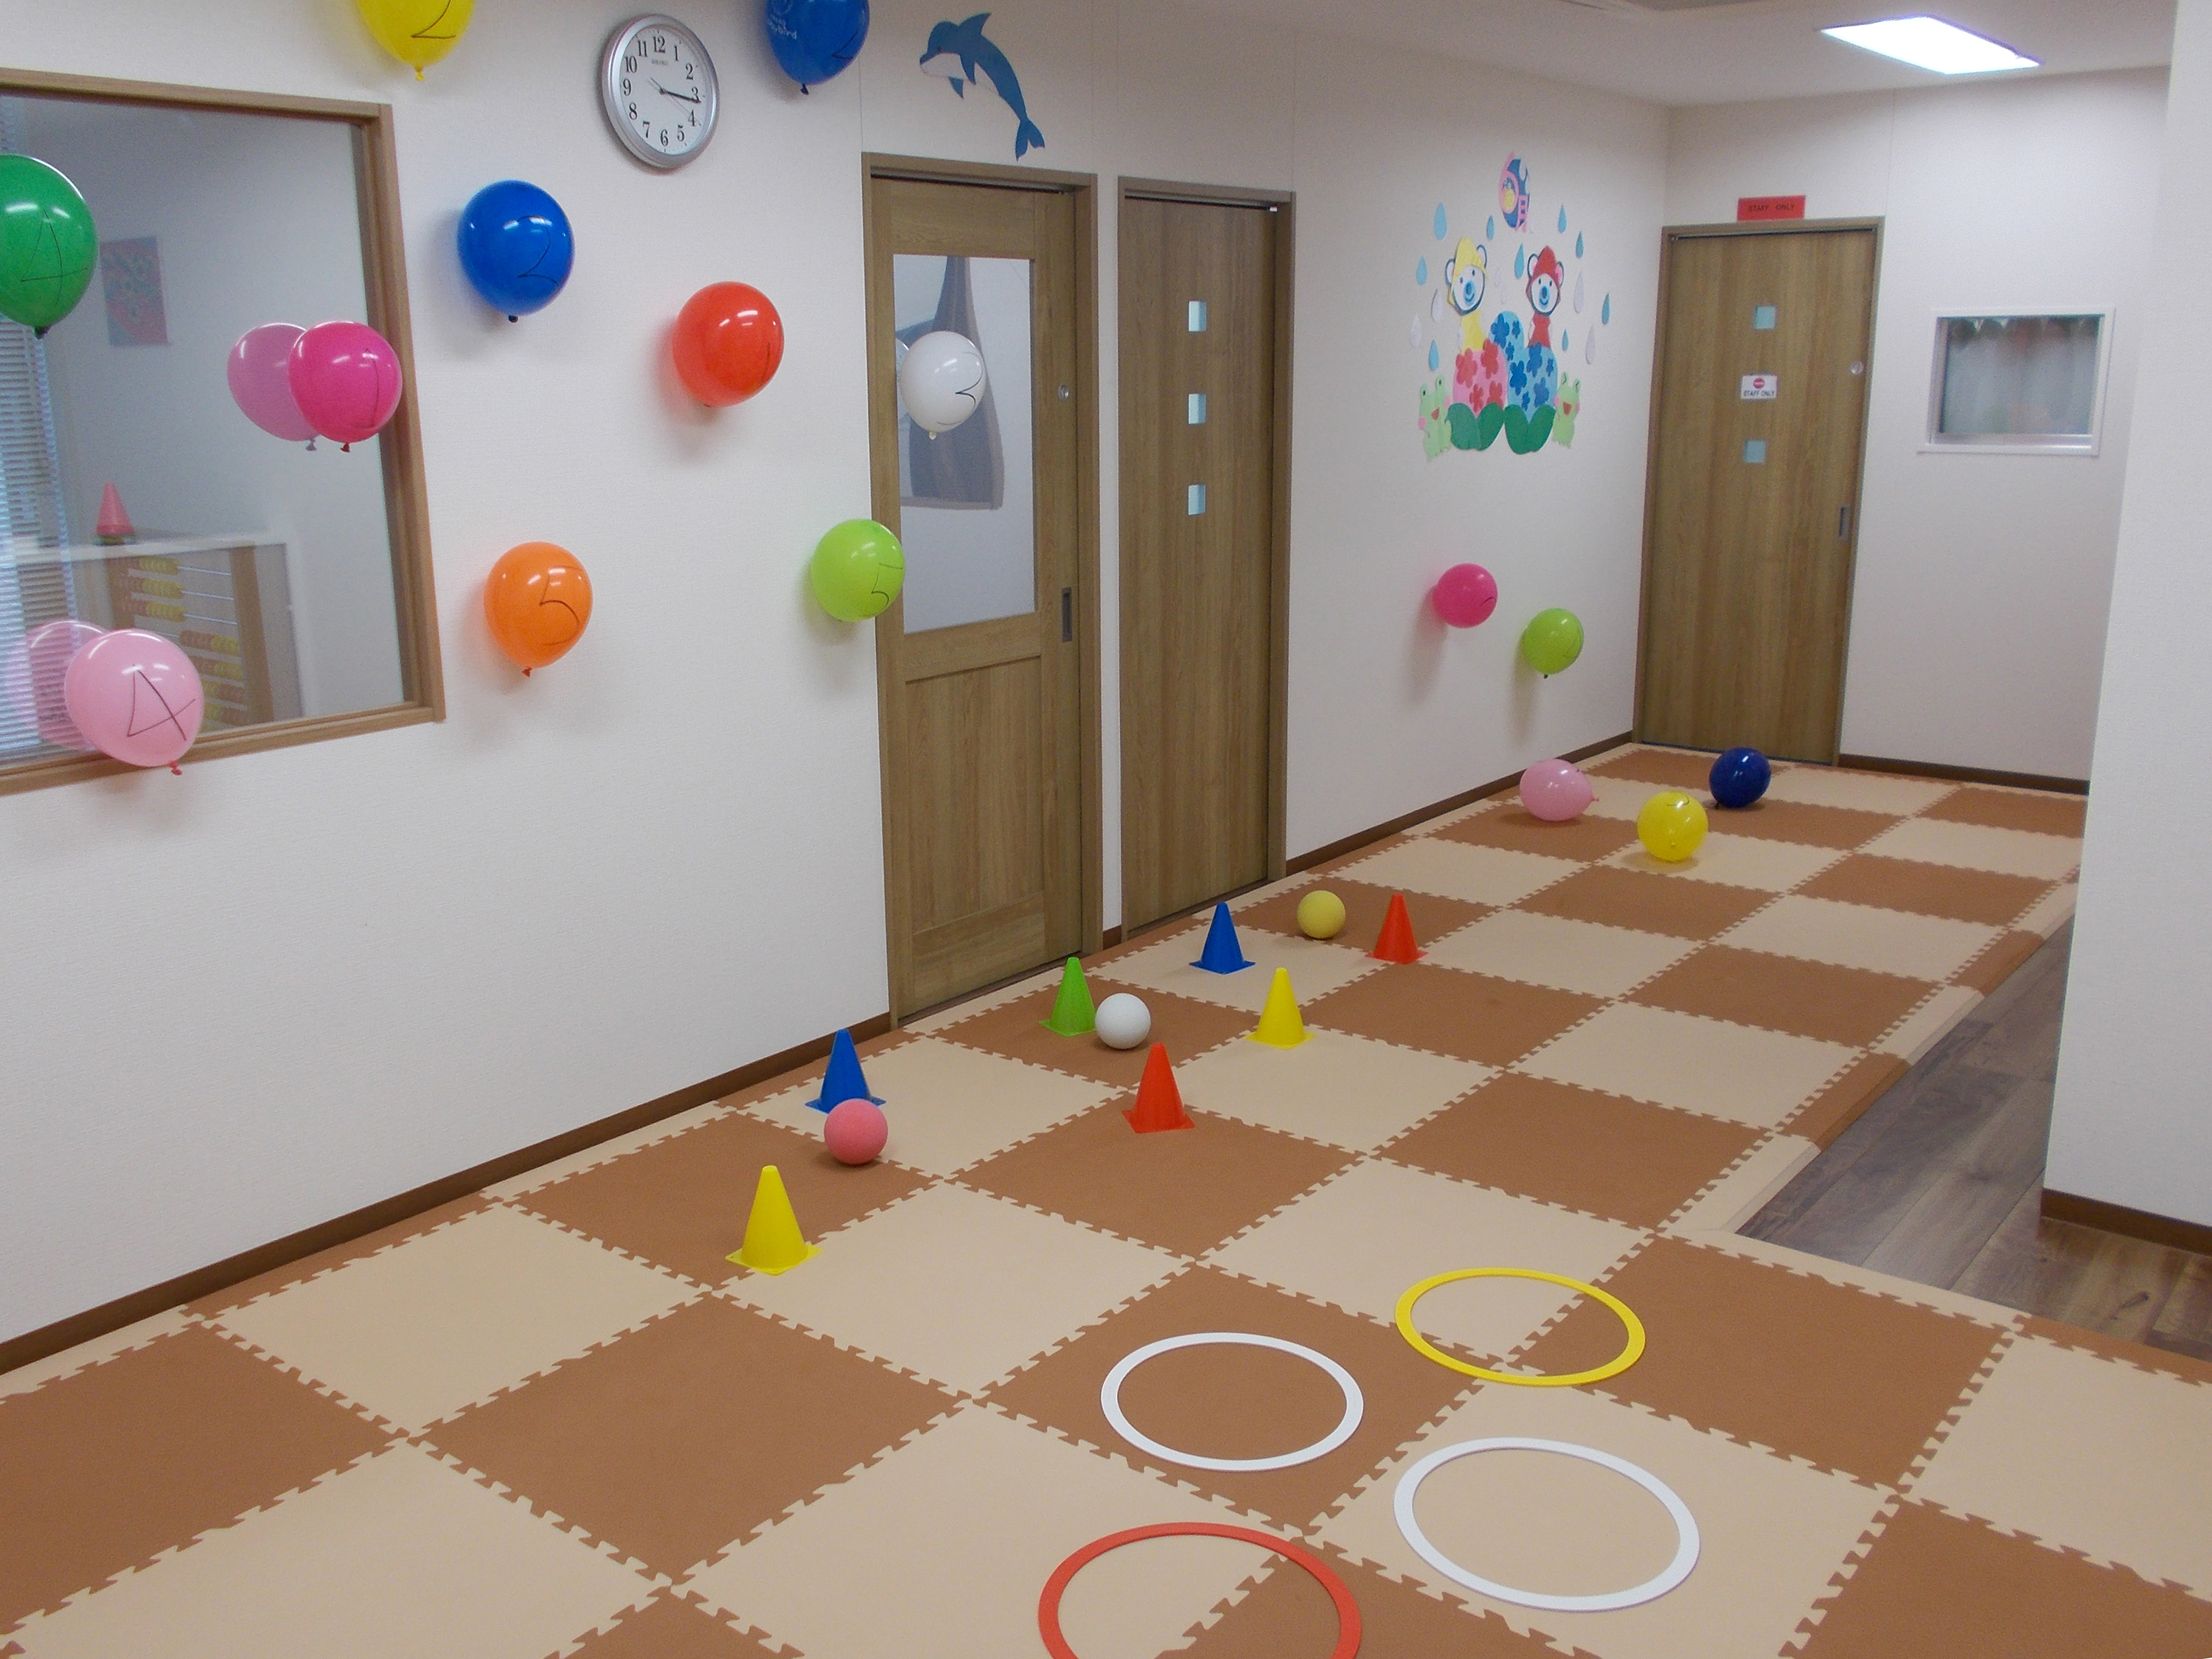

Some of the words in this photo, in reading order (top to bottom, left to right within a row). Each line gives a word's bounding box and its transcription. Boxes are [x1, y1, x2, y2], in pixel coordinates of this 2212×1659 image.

[637, 41, 648, 58] 11
[652, 36, 666, 53] 12
[674, 45, 679, 61] 1
[625, 56, 638, 74] 10
[686, 63, 694, 80] 2
[623, 78, 632, 96] 9
[692, 86, 700, 102] 3
[629, 102, 638, 120] 8
[688, 110, 695, 127] 4
[642, 121, 650, 138] 7
[660, 129, 668, 146] 6
[677, 125, 685, 142] 5
[1747, 204, 1769, 212] STAFF
[1775, 204, 1795, 212] ONLY
[21, 207, 88, 307] 4
[516, 215, 560, 286] 2
[936, 351, 984, 425] 3
[864, 563, 903, 616] 5
[539, 565, 585, 646] 5
[127, 664, 196, 741] 4
